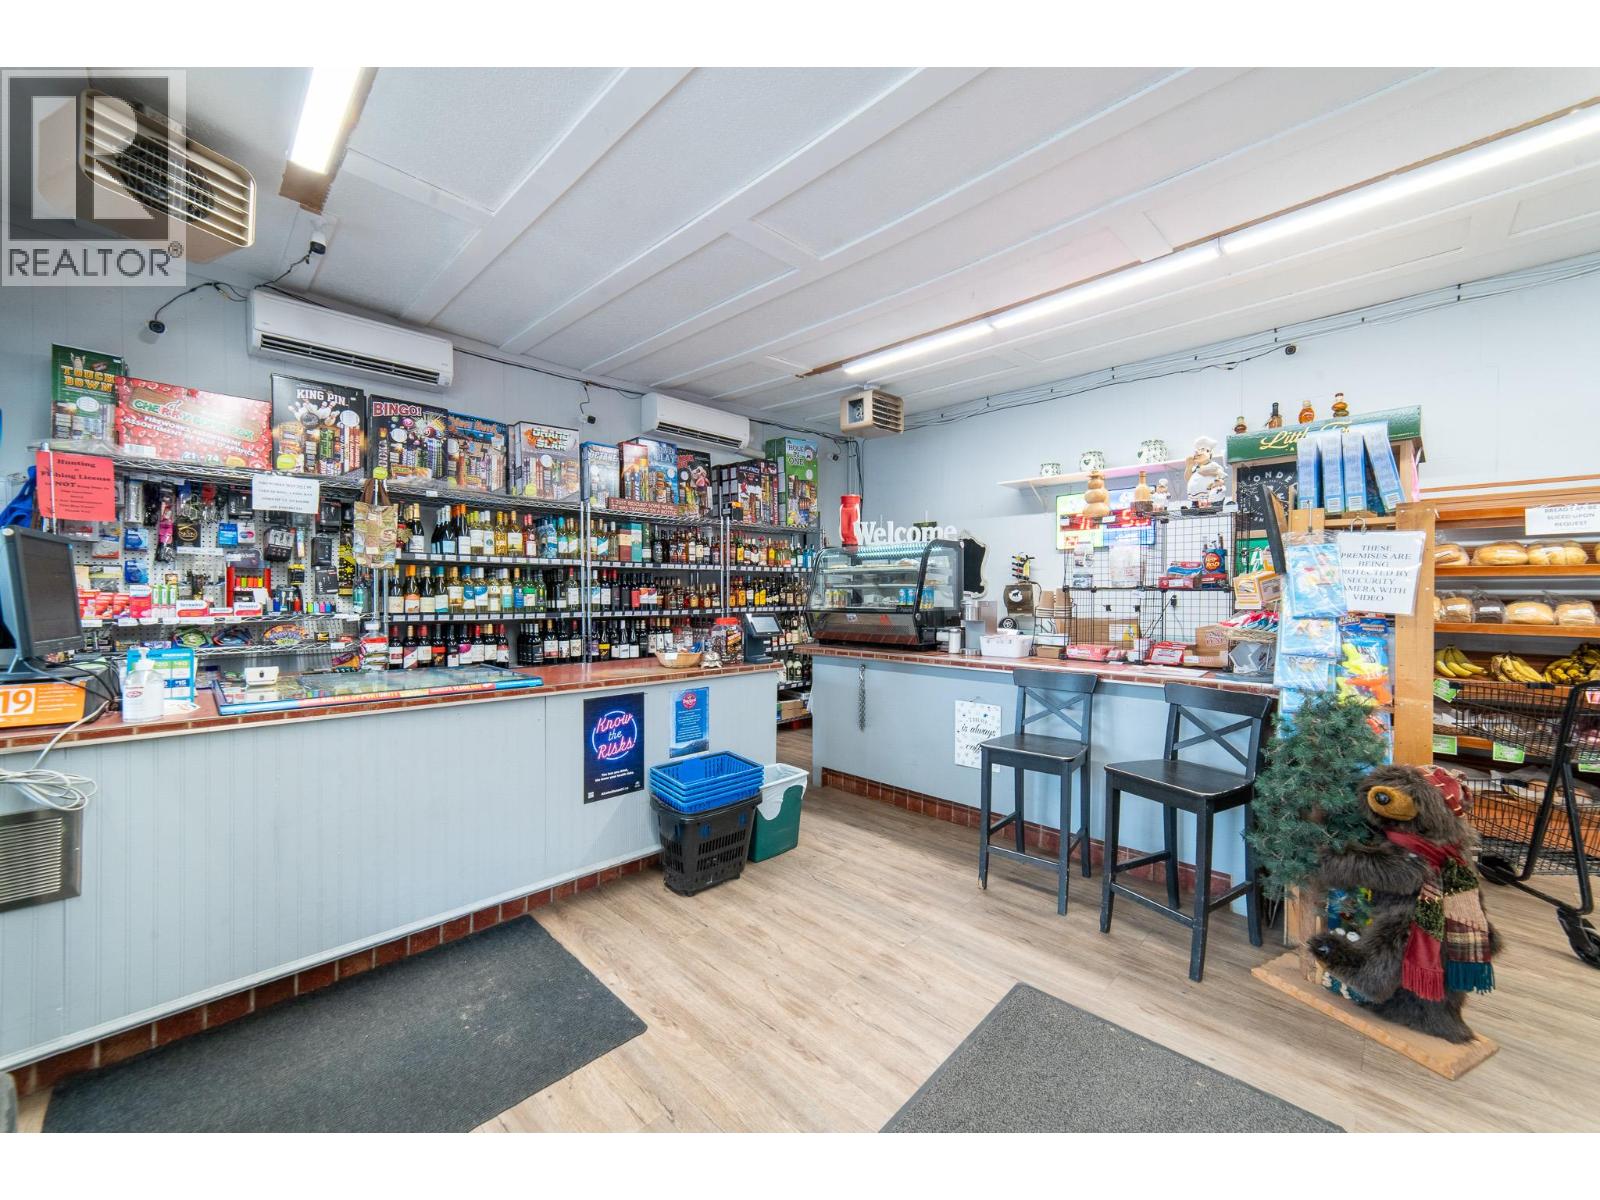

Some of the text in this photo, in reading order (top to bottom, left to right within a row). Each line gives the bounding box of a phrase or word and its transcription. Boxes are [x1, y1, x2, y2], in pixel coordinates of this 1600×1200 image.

[64, 375, 112, 393] DOWN
[296, 389, 346, 406] KING PIN
[372, 401, 422, 416] BINGO!
[57, 459, 96, 468] Hunting
[41, 470, 76, 480] Fihing
[854, 520, 958, 546] Welcome
[1340, 552, 1412, 560] PREMISES ARE
[1358, 560, 1391, 568] BEING
[1346, 577, 1396, 585] SECURITY
[1343, 585, 1407, 594] AMERA WITH
[596, 713, 633, 734] Know
[608, 728, 622, 741] the
[961, 723, 996, 739] is always
[598, 736, 635, 760] Risks
